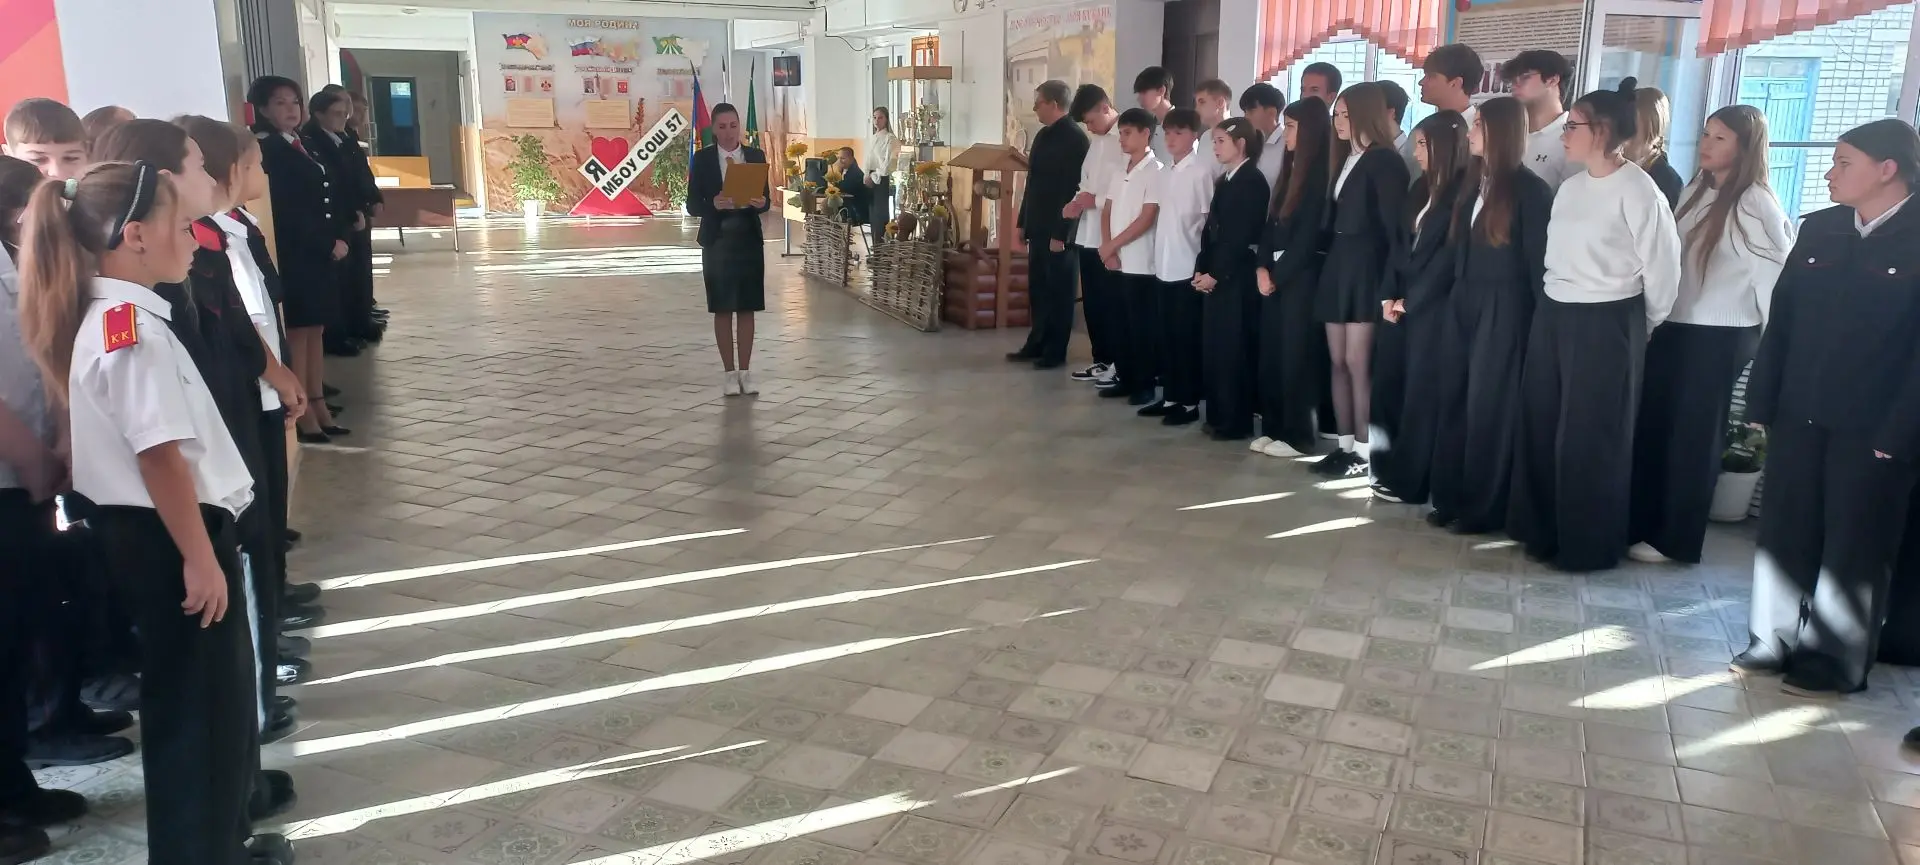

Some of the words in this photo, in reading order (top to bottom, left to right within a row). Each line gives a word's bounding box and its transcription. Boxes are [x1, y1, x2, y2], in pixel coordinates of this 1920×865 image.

[567, 19, 591, 28] МОЯ
[594, 19, 640, 30] РОДИНА
[601, 158, 637, 197] МБОУ
[637, 129, 668, 161] СОШ
[665, 113, 682, 132] 57
[584, 158, 607, 183] Я
